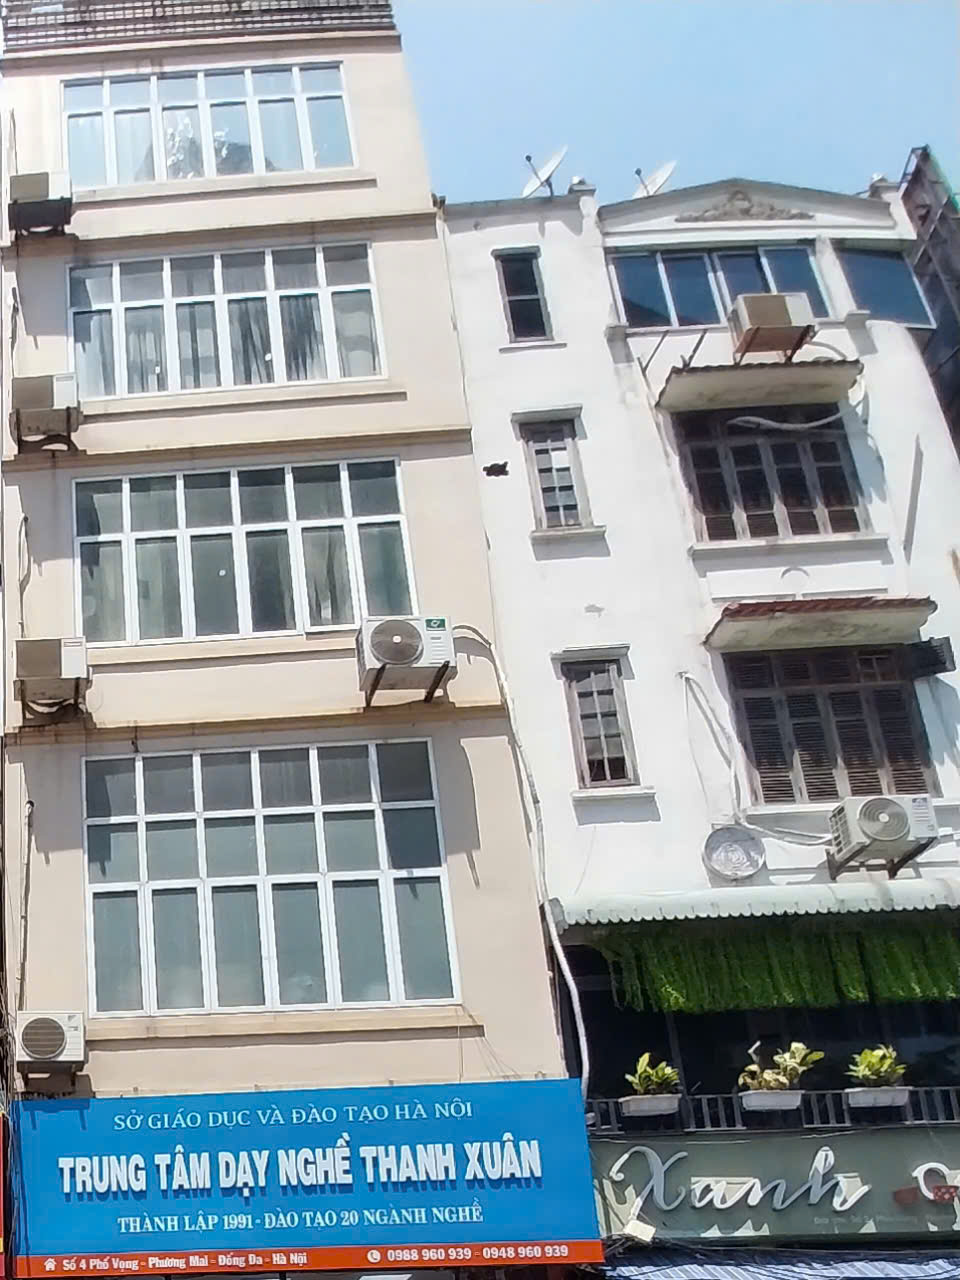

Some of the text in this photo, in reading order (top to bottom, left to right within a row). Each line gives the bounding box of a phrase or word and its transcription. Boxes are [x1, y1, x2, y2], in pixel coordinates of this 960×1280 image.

[113, 1096, 473, 1131] SỞ GIÁO DỤC VÀ ĐÀO TẠO HÀ NỘI
[57, 1132, 544, 1198] TRUNG TÂM DẠY NGHỀ THANH XUÂN
[609, 1145, 872, 1220] Xanh
[117, 1211, 180, 1234] THÀNH
[183, 1209, 219, 1234] LẬP
[222, 1213, 254, 1231] 1991
[263, 1207, 300, 1230] ĐÀO
[302, 1208, 338, 1229] TẠO
[340, 1209, 360, 1227] 20
[362, 1203, 428, 1226] NGÀNH
[431, 1196, 484, 1223] NGHỀ
[62, 1256, 77, 1271] Số
[79, 1258, 87, 1271] 4
[89, 1256, 111, 1270] Phố
[111, 1257, 139, 1272] Vọng
[147, 1256, 187, 1269] Phương
[217, 1252, 246, 1268] Đống
[271, 1252, 287, 1265] Hà
[289, 1251, 308, 1267] Nội
[387, 1248, 420, 1262] 0988
[421, 1248, 445, 1261] 960
[447, 1247, 472, 1260] 939
[482, 1246, 515, 1259] 0948
[517, 1245, 542, 1258] 960
[544, 1244, 569, 1258] 939
